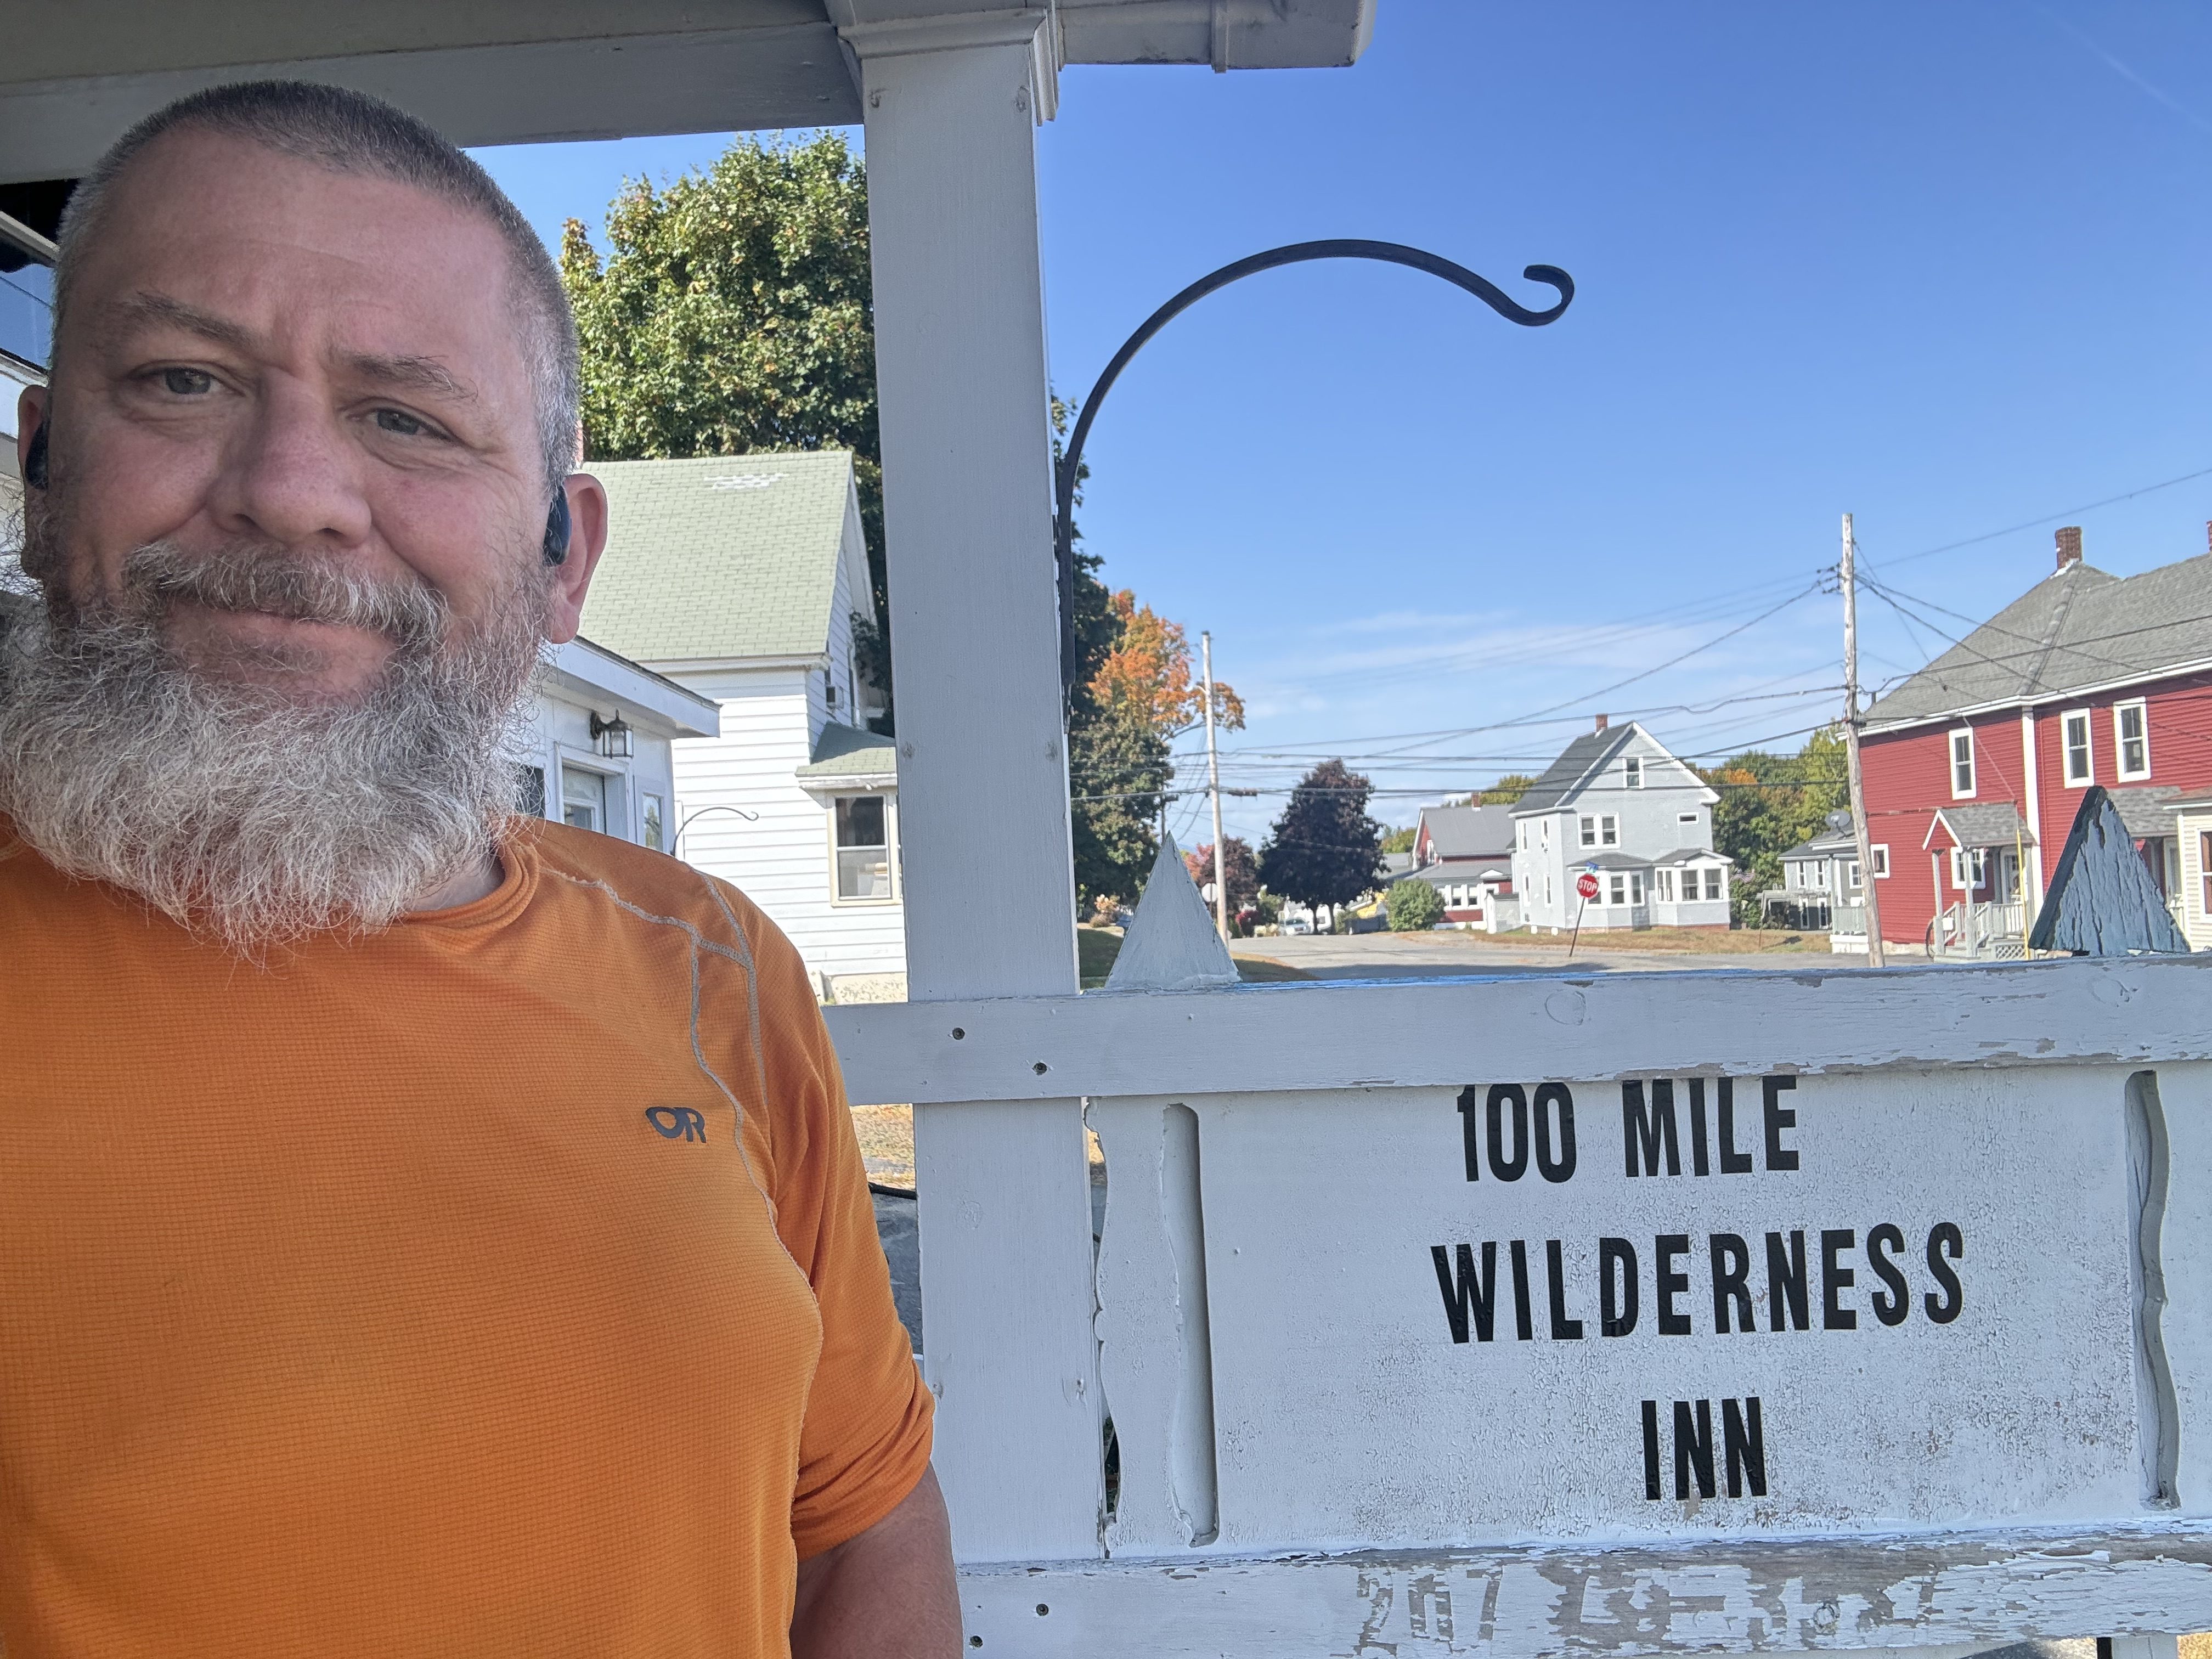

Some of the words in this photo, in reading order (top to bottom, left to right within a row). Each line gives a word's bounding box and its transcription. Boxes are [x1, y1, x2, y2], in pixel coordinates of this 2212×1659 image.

[1578, 879, 1598, 893] STOP
[645, 1107, 706, 1143] OR
[1457, 1083, 1577, 1183] 100
[1621, 1076, 1799, 1177] MILE
[1430, 1222, 1963, 1344] WILDERNESS
[1641, 1396, 1767, 1501] INN
